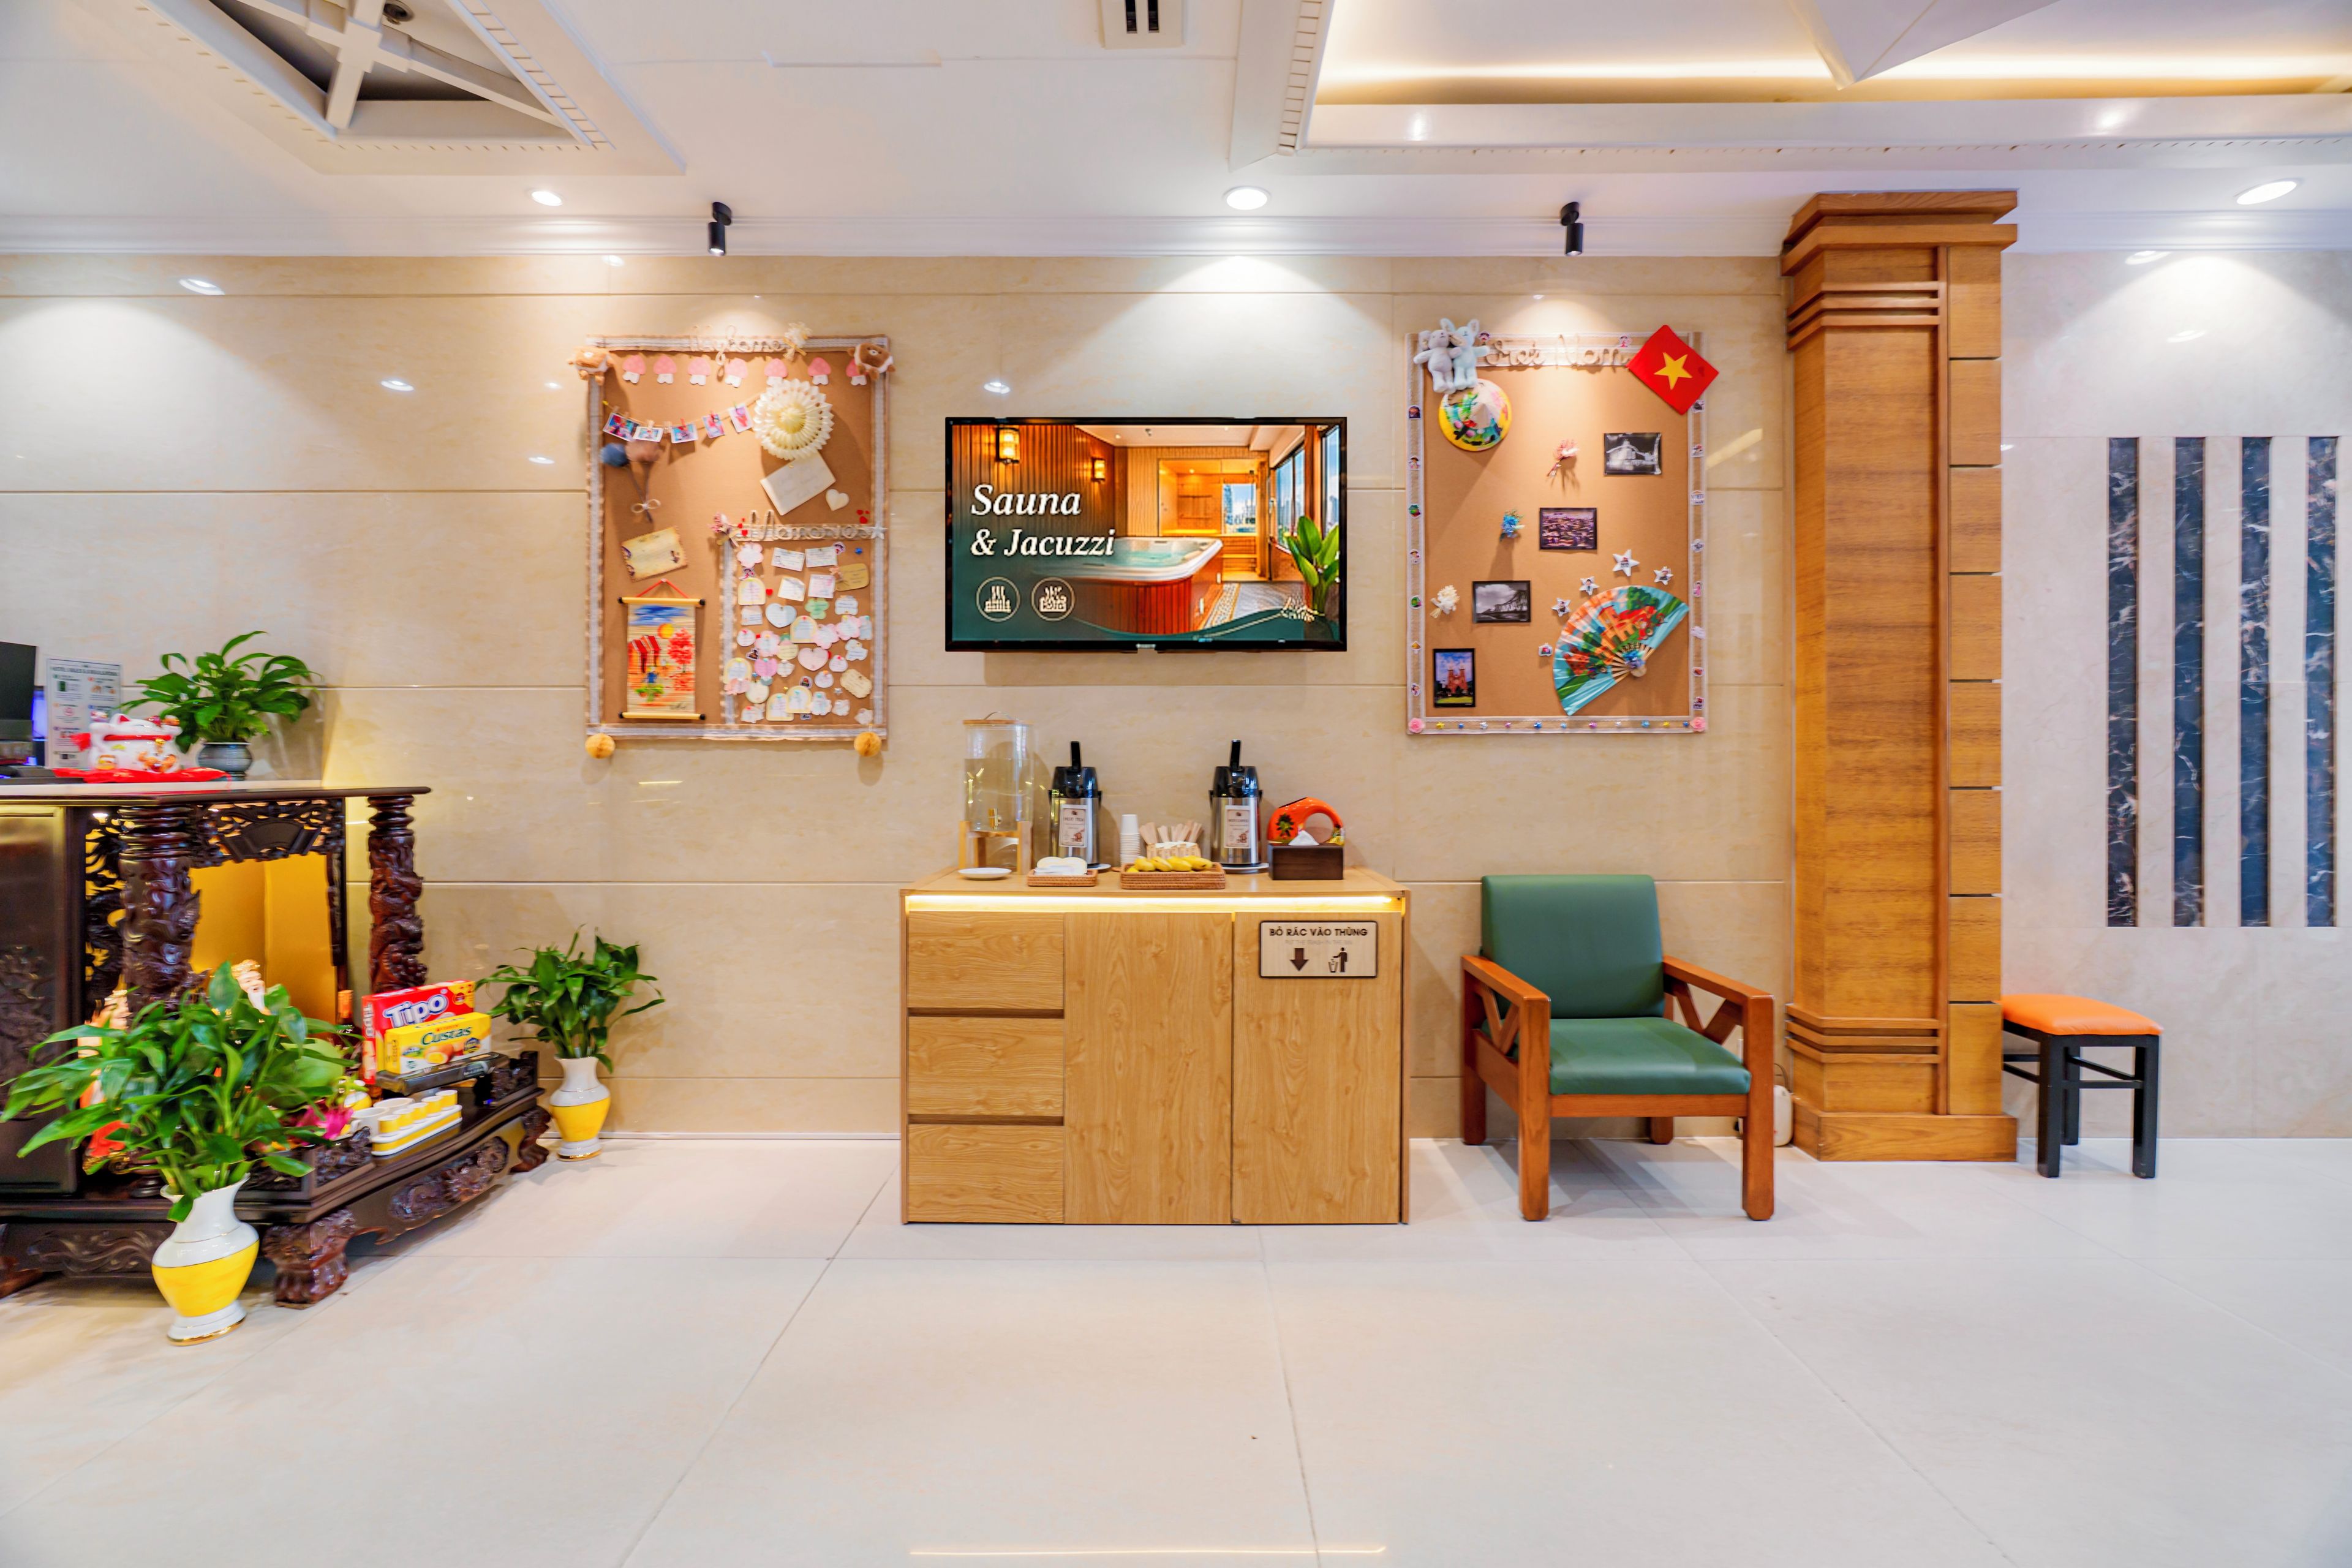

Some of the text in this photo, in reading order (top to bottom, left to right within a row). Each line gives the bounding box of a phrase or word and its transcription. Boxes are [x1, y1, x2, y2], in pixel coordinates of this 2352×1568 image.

[971, 484, 1081, 516] Sauna
[971, 528, 1115, 557] & Jacuzzi
[1269, 926, 1368, 937] BỎ RÁC VÀO THÙNG
[421, 1027, 472, 1046] Custas
